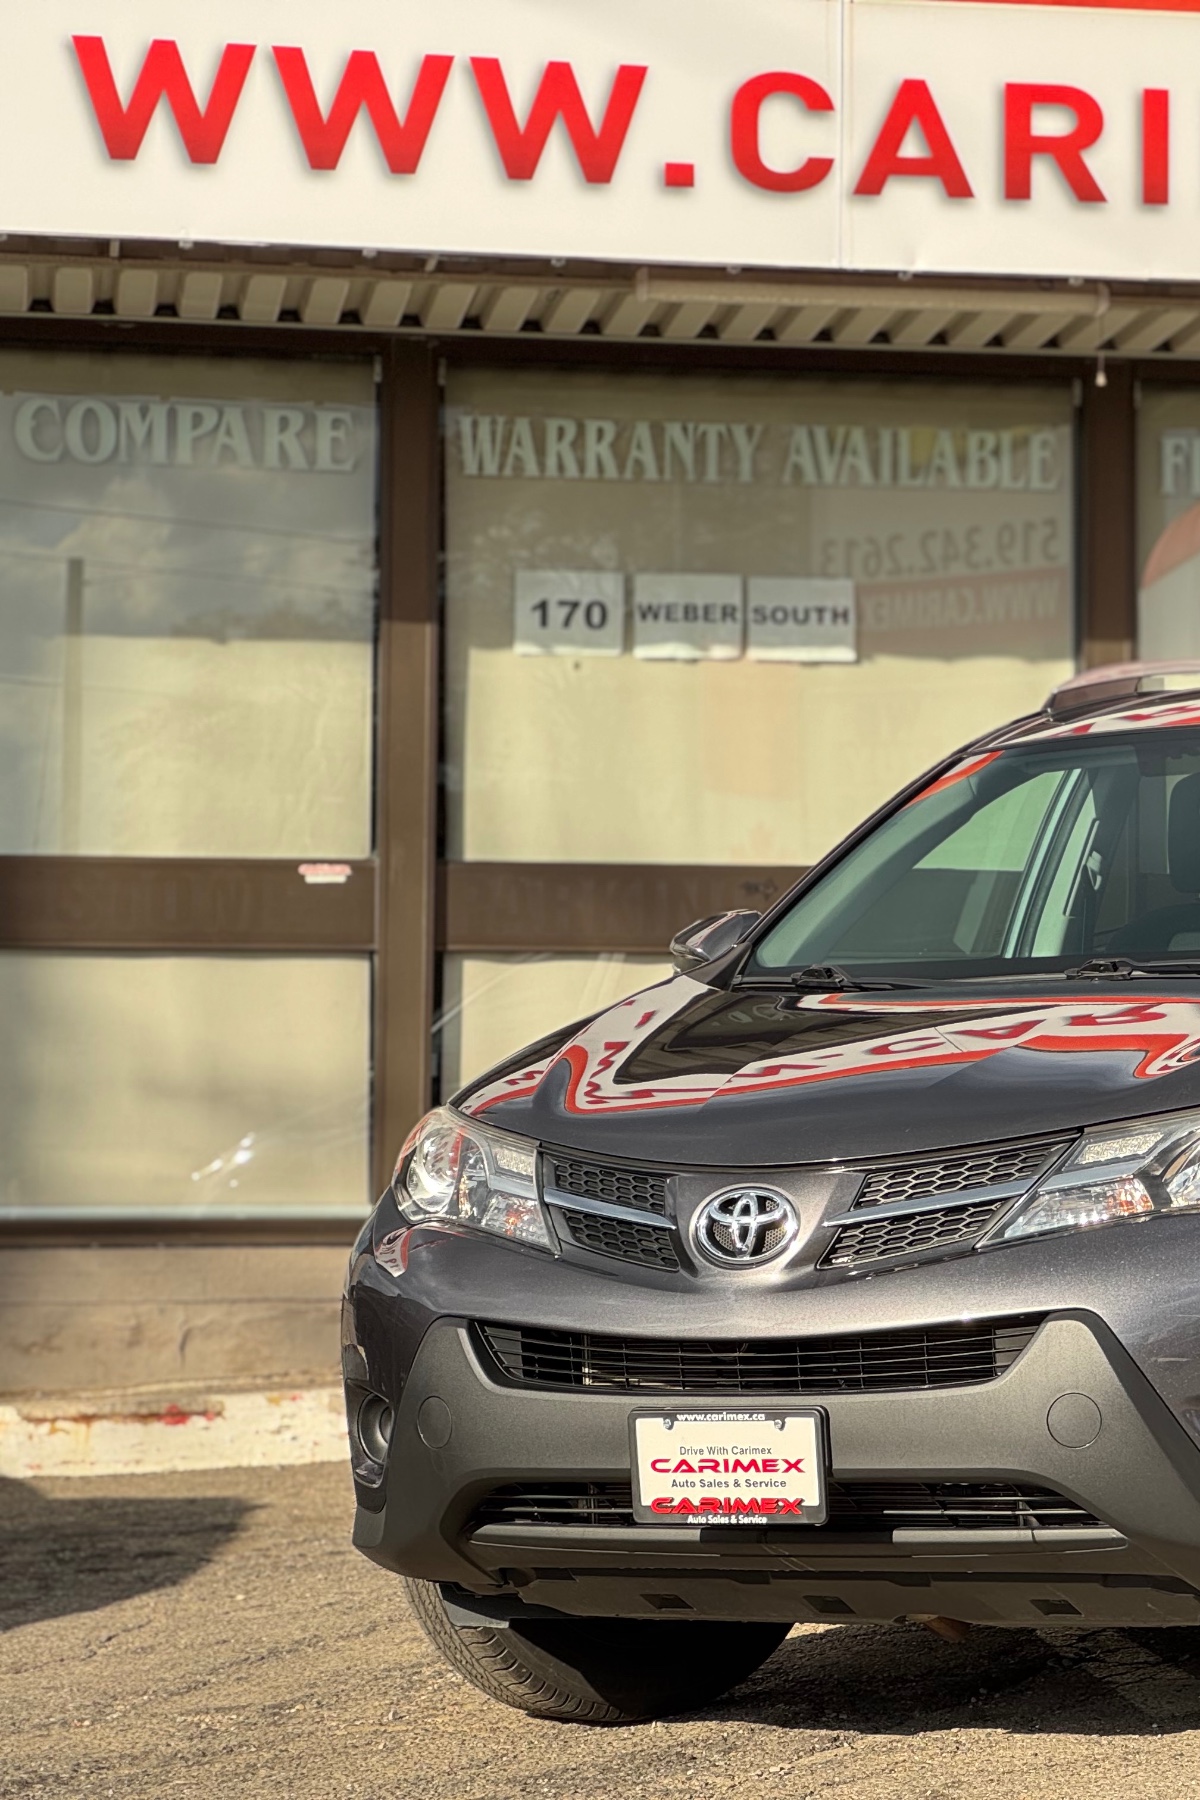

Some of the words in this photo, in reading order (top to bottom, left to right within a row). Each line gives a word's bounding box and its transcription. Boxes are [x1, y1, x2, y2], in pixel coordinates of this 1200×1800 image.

[13, 399, 359, 473] COMPARE
[458, 414, 762, 484] WARRANTY
[784, 424, 1059, 492] AVAILABLE
[530, 600, 608, 630] 170
[638, 603, 739, 623] WEBER
[751, 605, 850, 627] SOUTH
[676, 1412, 766, 1422] www.carimex.ca
[679, 1446, 704, 1456] Drive
[706, 1445, 729, 1455] With
[731, 1445, 772, 1455] Carimex
[650, 1458, 805, 1473] CARIMEX
[671, 1479, 696, 1488] Auto
[699, 1479, 729, 1488] Sales
[733, 1479, 741, 1488] &
[744, 1479, 787, 1488] Service
[651, 1497, 802, 1514] CARIMEX
[687, 1514, 706, 1524] Auto
[707, 1514, 730, 1524] Sales
[730, 1515, 738, 1524] &
[738, 1514, 768, 1524] Service
